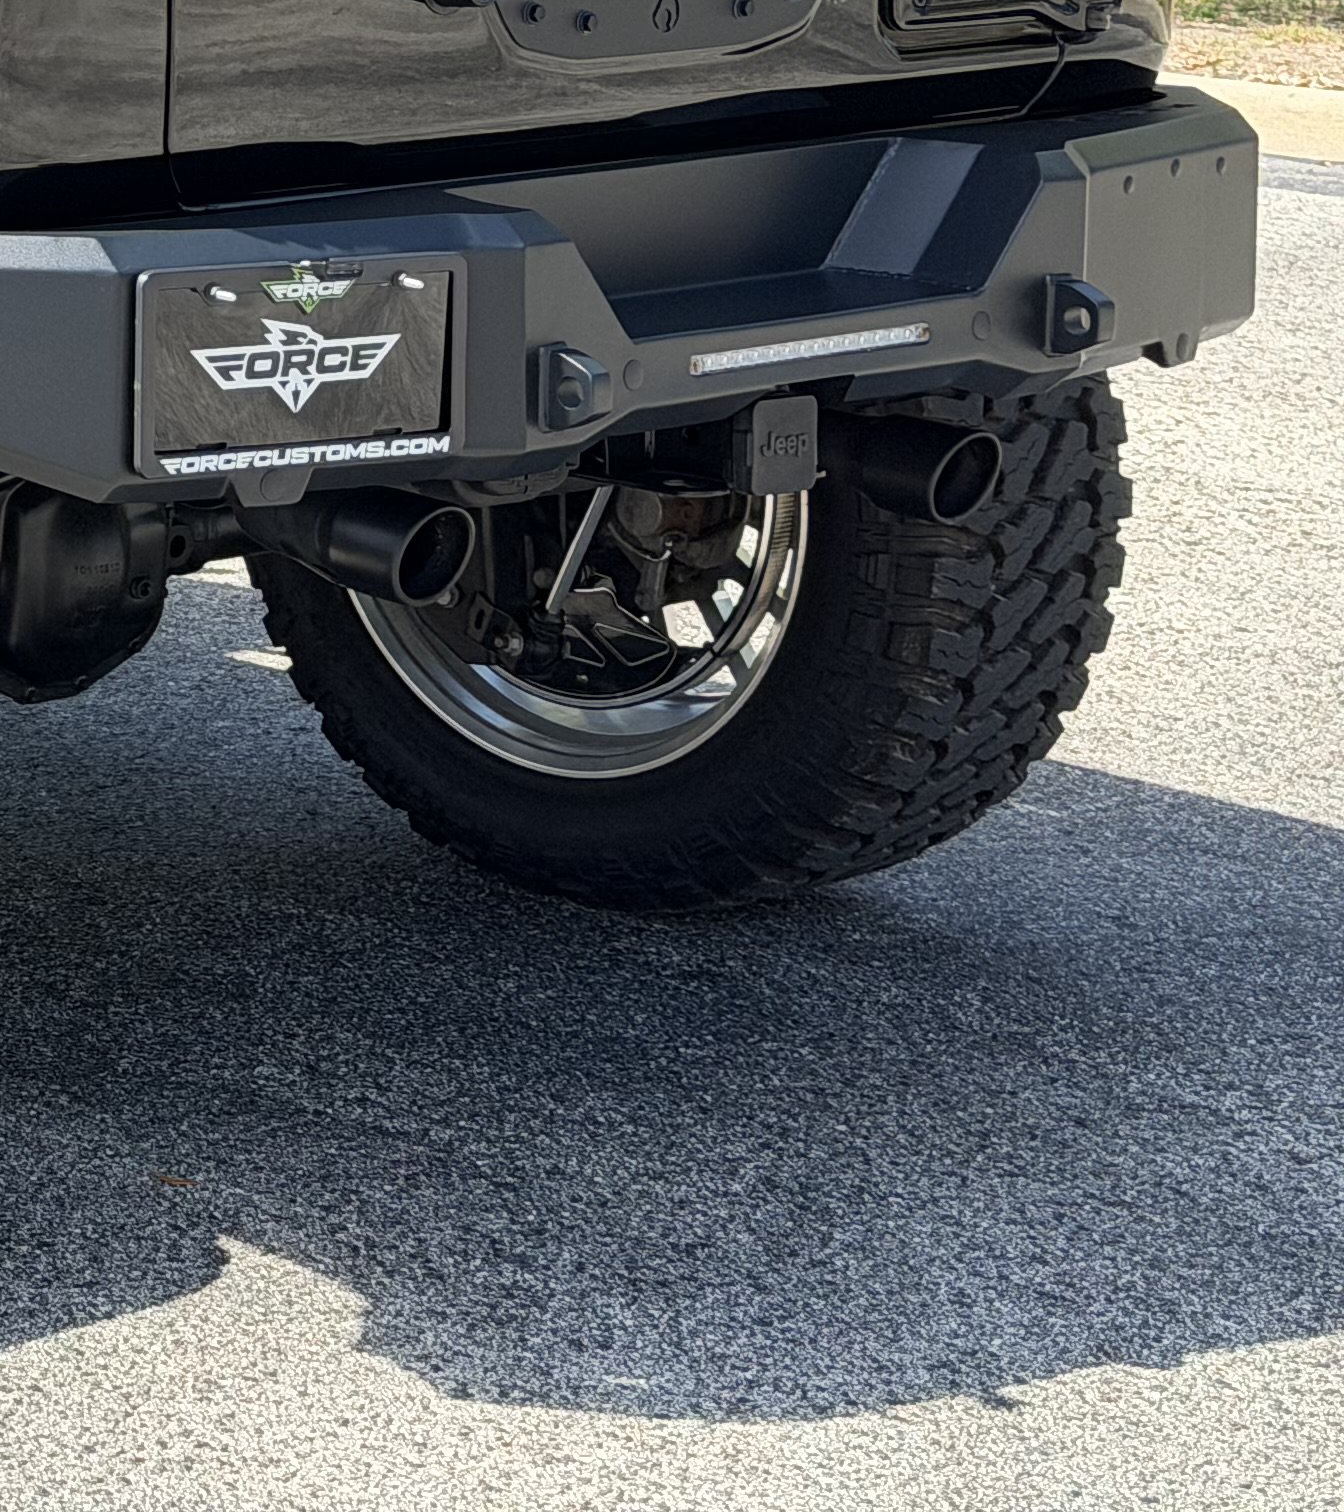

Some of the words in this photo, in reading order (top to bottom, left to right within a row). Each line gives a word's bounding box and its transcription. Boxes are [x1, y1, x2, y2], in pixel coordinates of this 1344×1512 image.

[266, 277, 352, 301] FORCE
[201, 341, 395, 384] FORCE
[159, 435, 451, 475] FORCECUSTOMS.COM
[759, 430, 810, 458] Jeep
